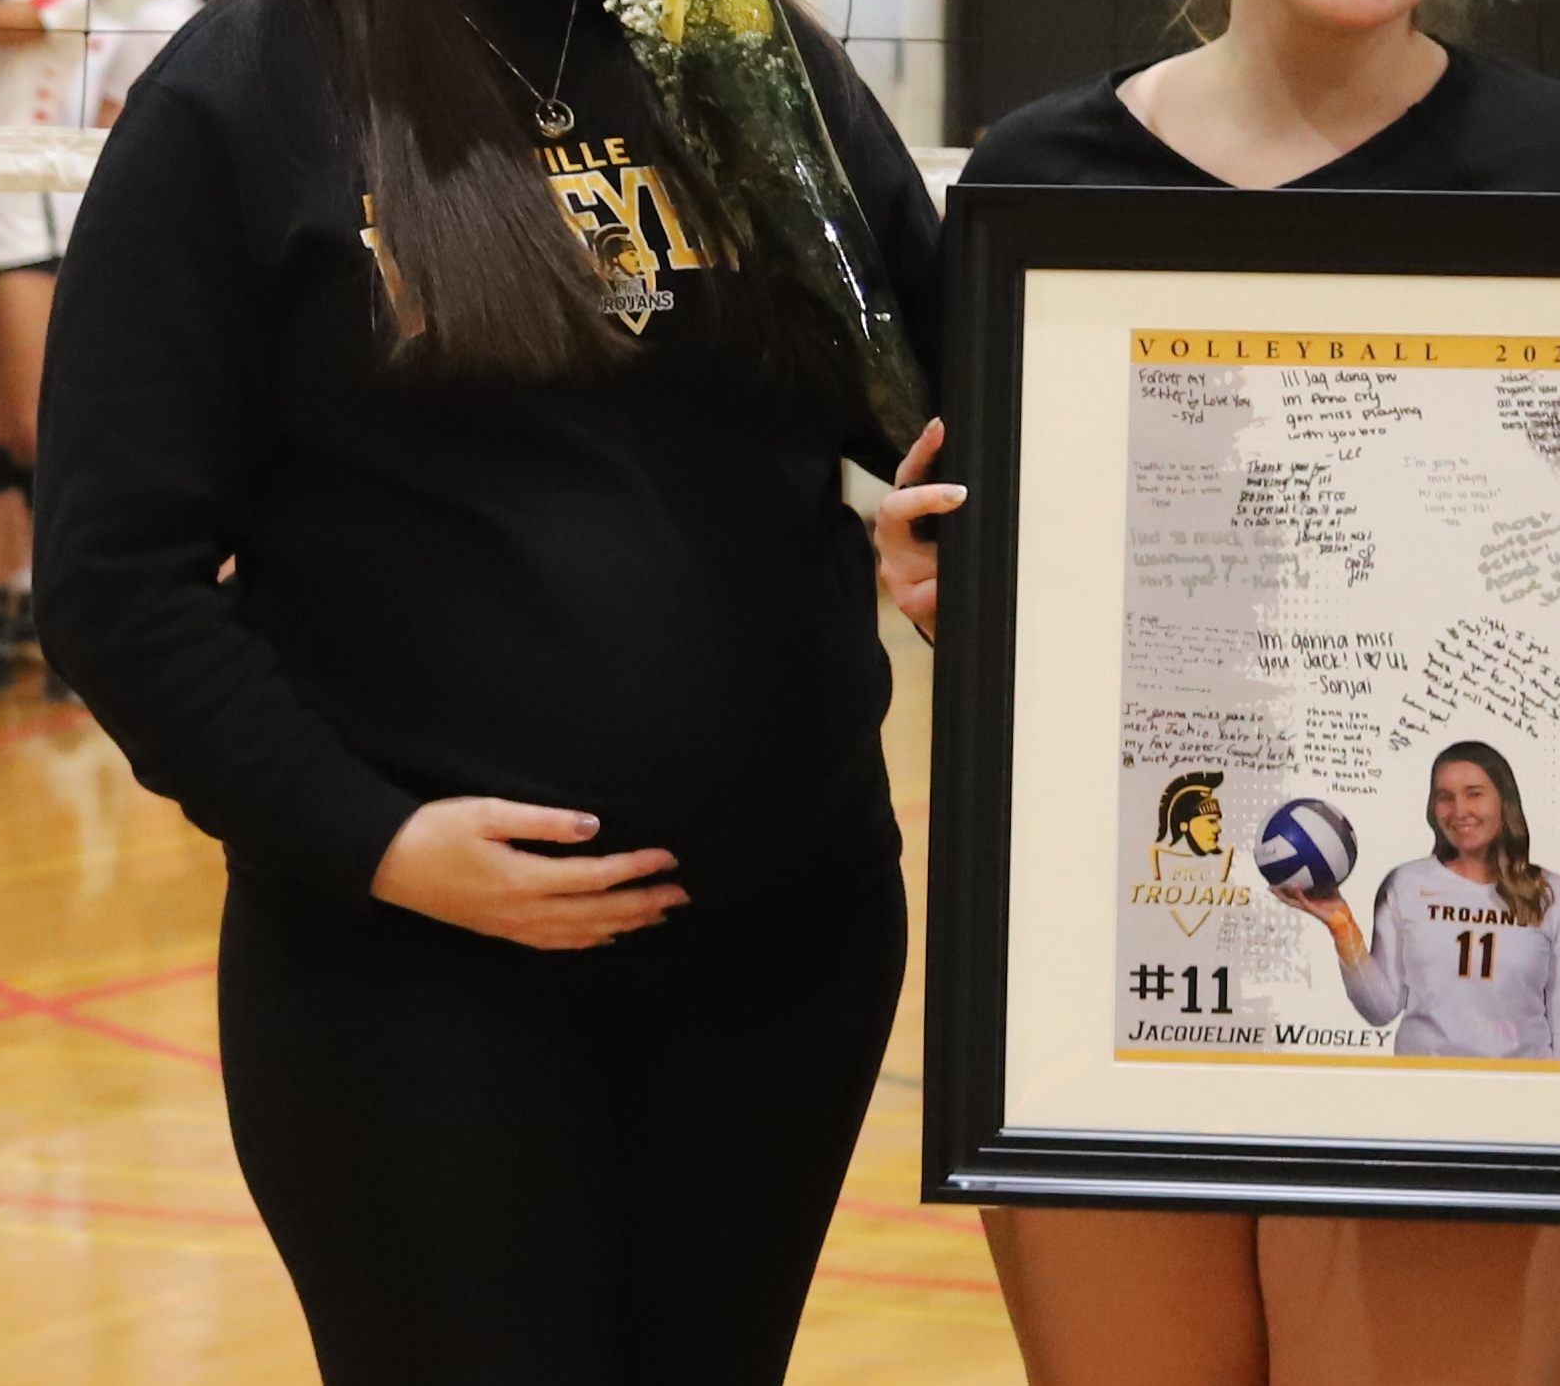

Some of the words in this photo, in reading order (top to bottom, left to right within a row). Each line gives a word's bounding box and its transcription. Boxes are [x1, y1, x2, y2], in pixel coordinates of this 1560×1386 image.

[1138, 338, 1438, 361] VOLLEYBALL
[1187, 373, 1206, 387] my
[1335, 370, 1372, 391] dang
[1354, 390, 1381, 409] cry
[1362, 406, 1424, 422] playing
[1318, 490, 1347, 502] FTCC
[1291, 633, 1348, 654] gonna
[1355, 631, 1394, 647] miss
[1257, 654, 1290, 676] you
[1147, 709, 1187, 722] gonna
[1124, 739, 1144, 754] my
[1130, 883, 1252, 906] TROJANS
[1427, 904, 1529, 927] TROJAN
[1456, 929, 1497, 981] 11
[1129, 964, 1233, 1015] #11
